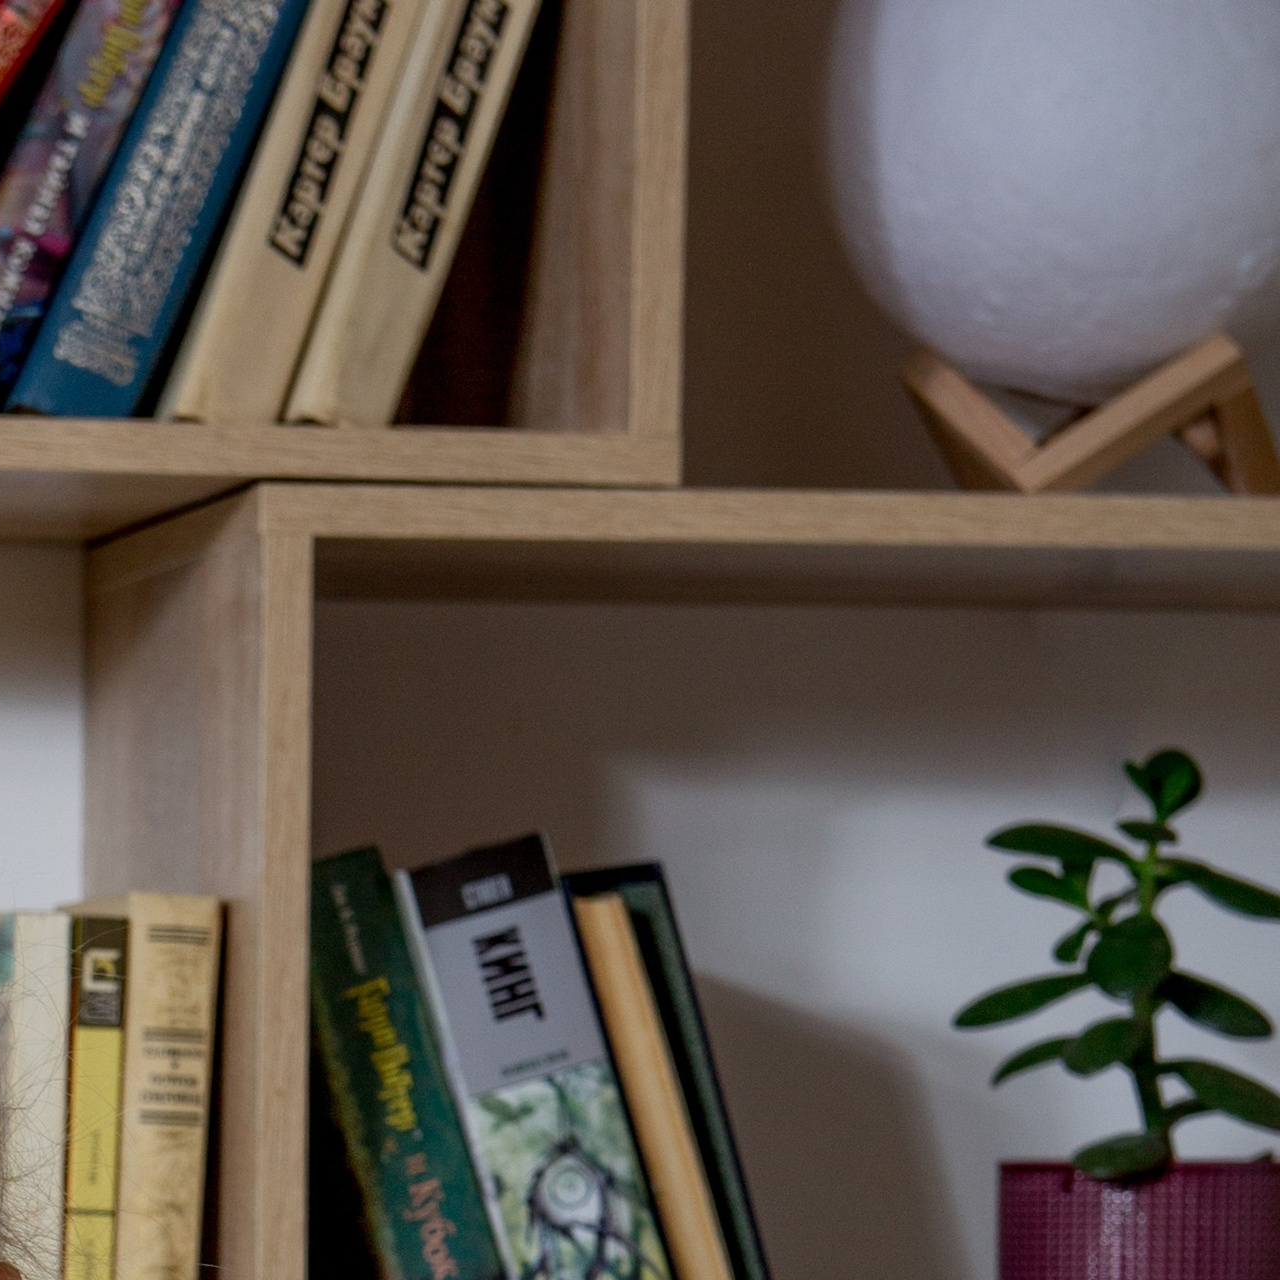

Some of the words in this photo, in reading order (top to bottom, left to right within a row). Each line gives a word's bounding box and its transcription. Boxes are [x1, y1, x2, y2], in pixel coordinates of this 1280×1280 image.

[273, 112, 346, 260] Картер
[396, 115, 466, 263] Картер
[473, 924, 545, 1022] КИНГ
